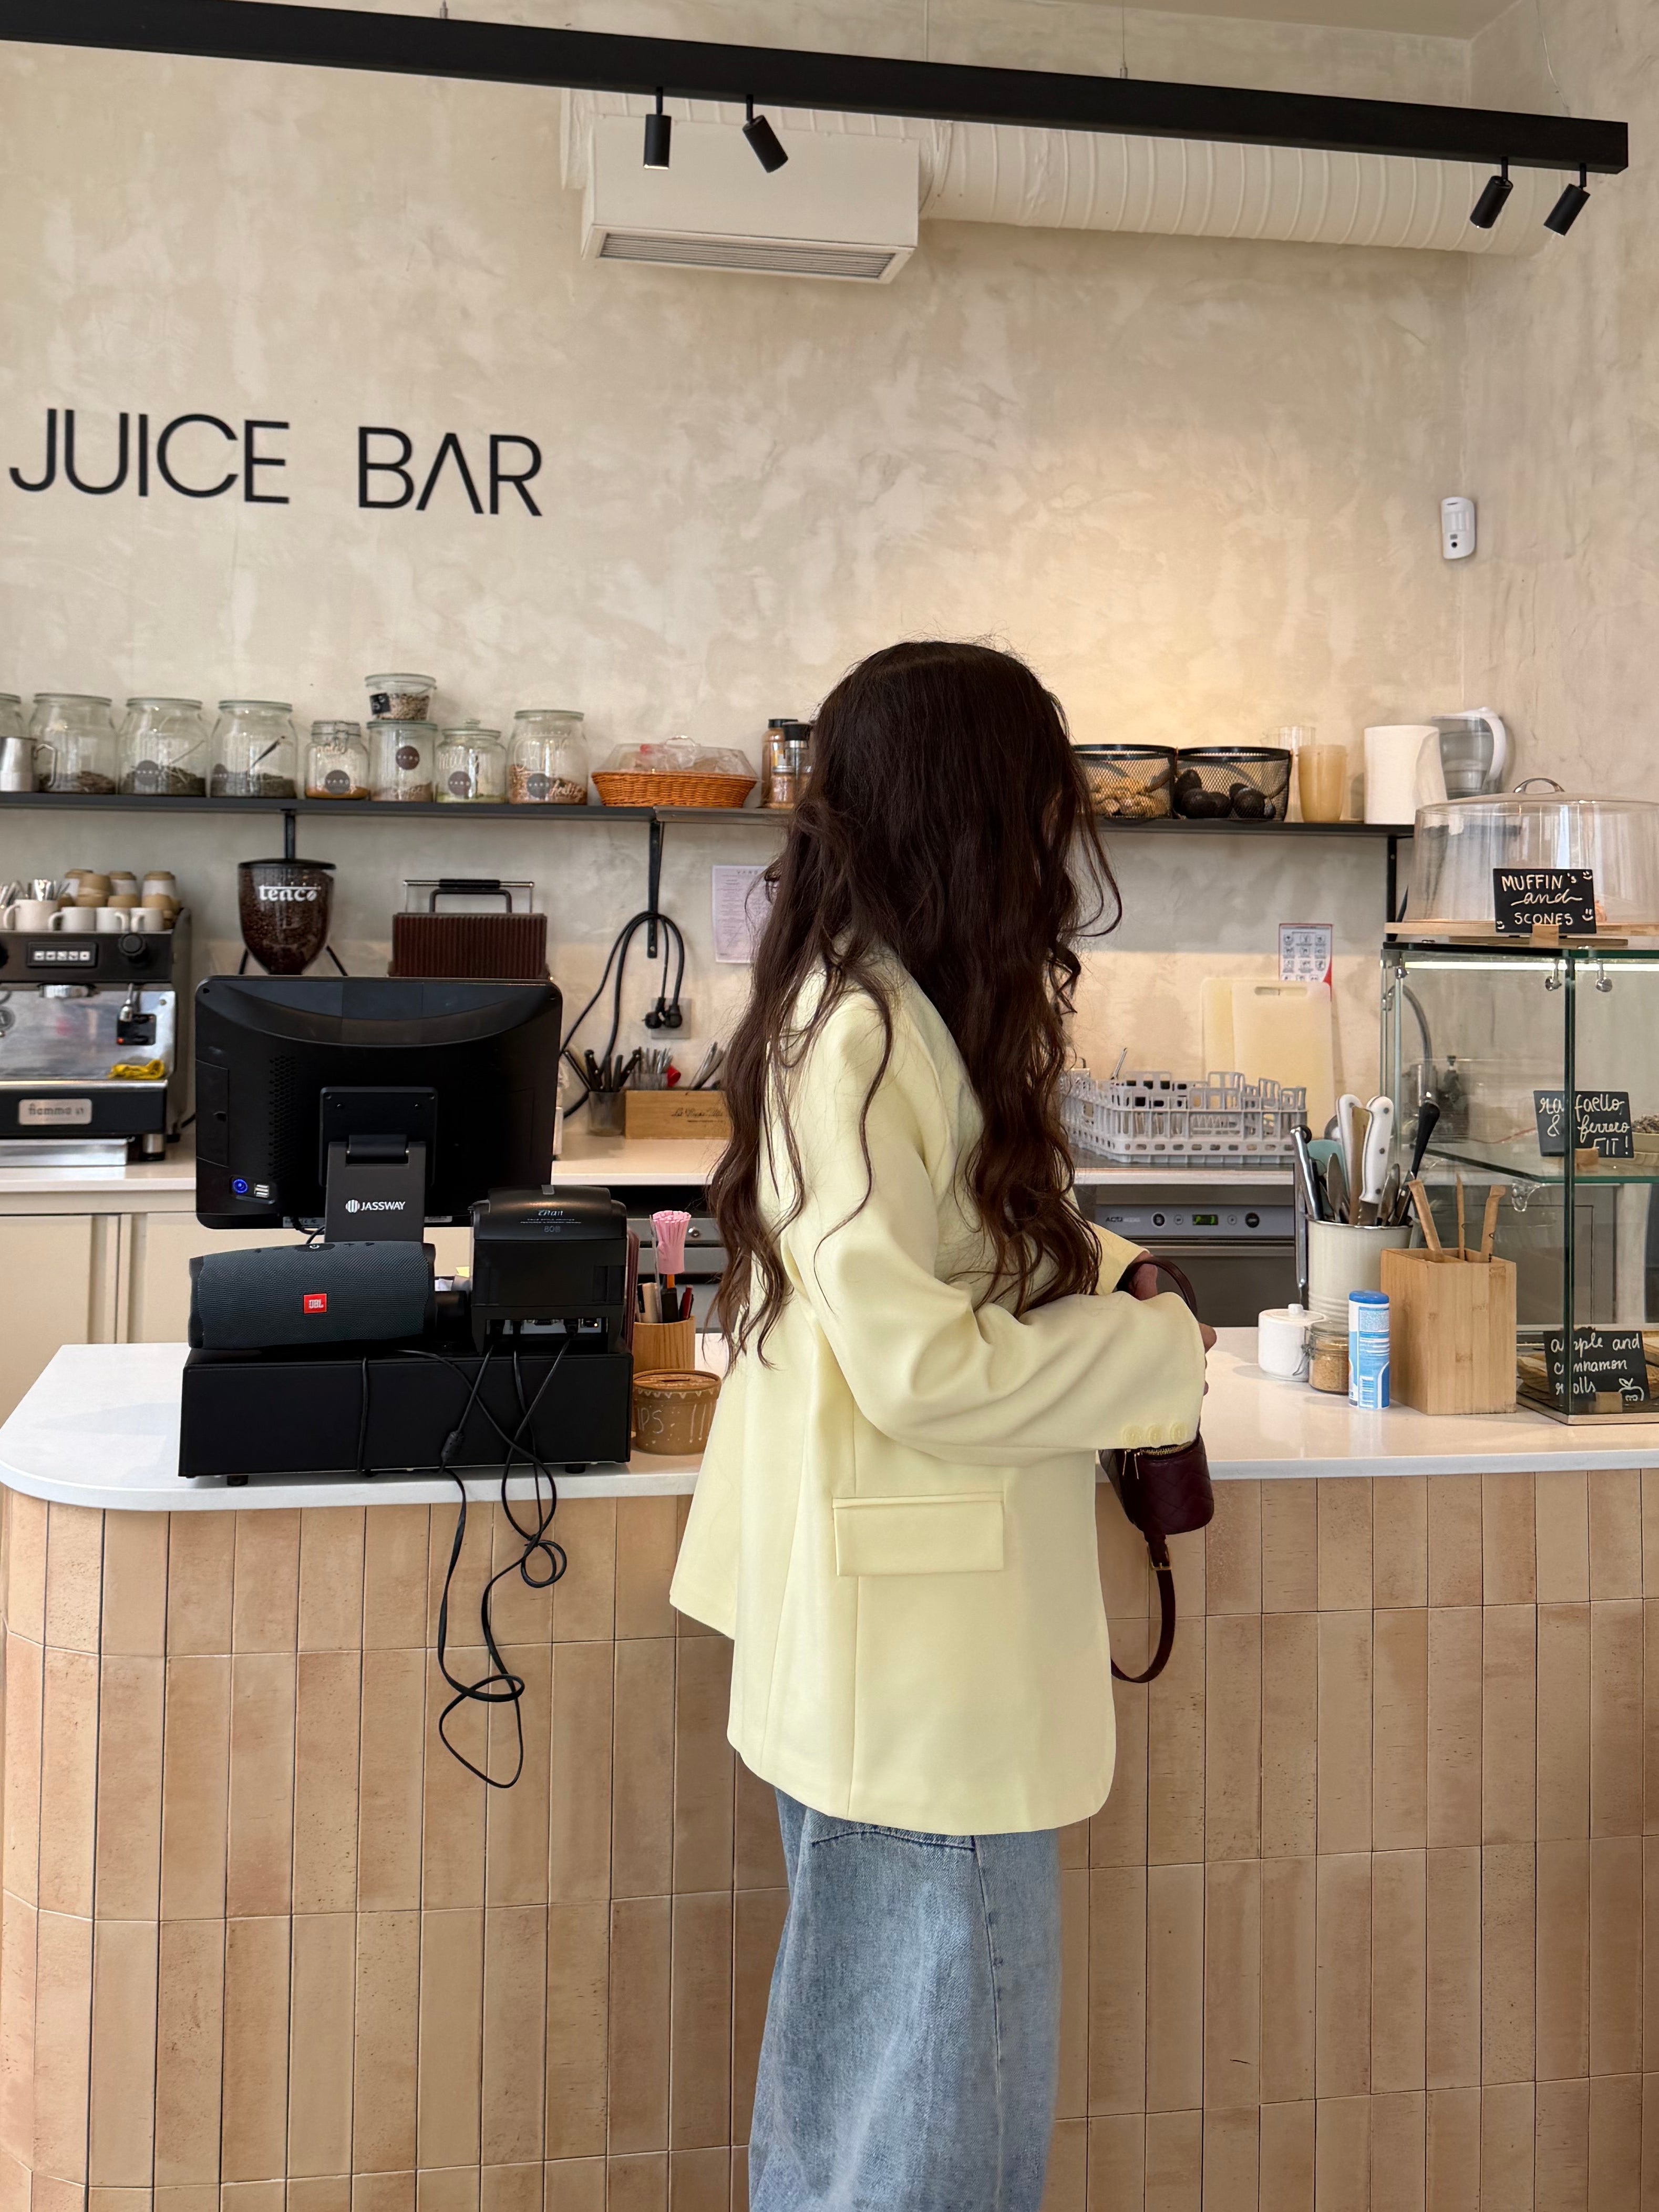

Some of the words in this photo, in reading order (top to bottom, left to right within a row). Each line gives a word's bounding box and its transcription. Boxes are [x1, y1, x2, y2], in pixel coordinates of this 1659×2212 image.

[9, 408, 290, 504] JUICE
[358, 426, 542, 517] BAR
[1510, 888, 1583, 906] and
[1514, 912, 1573, 925] SCONES
[1547, 1114, 1560, 1137] &
[1578, 1114, 1630, 1144] ferrero
[360, 1201, 406, 1211] JASSWAY
[308, 1299, 324, 1309] JBL
[1612, 1333, 1641, 1351] and
[1553, 1359, 1627, 1375] cnnamon
